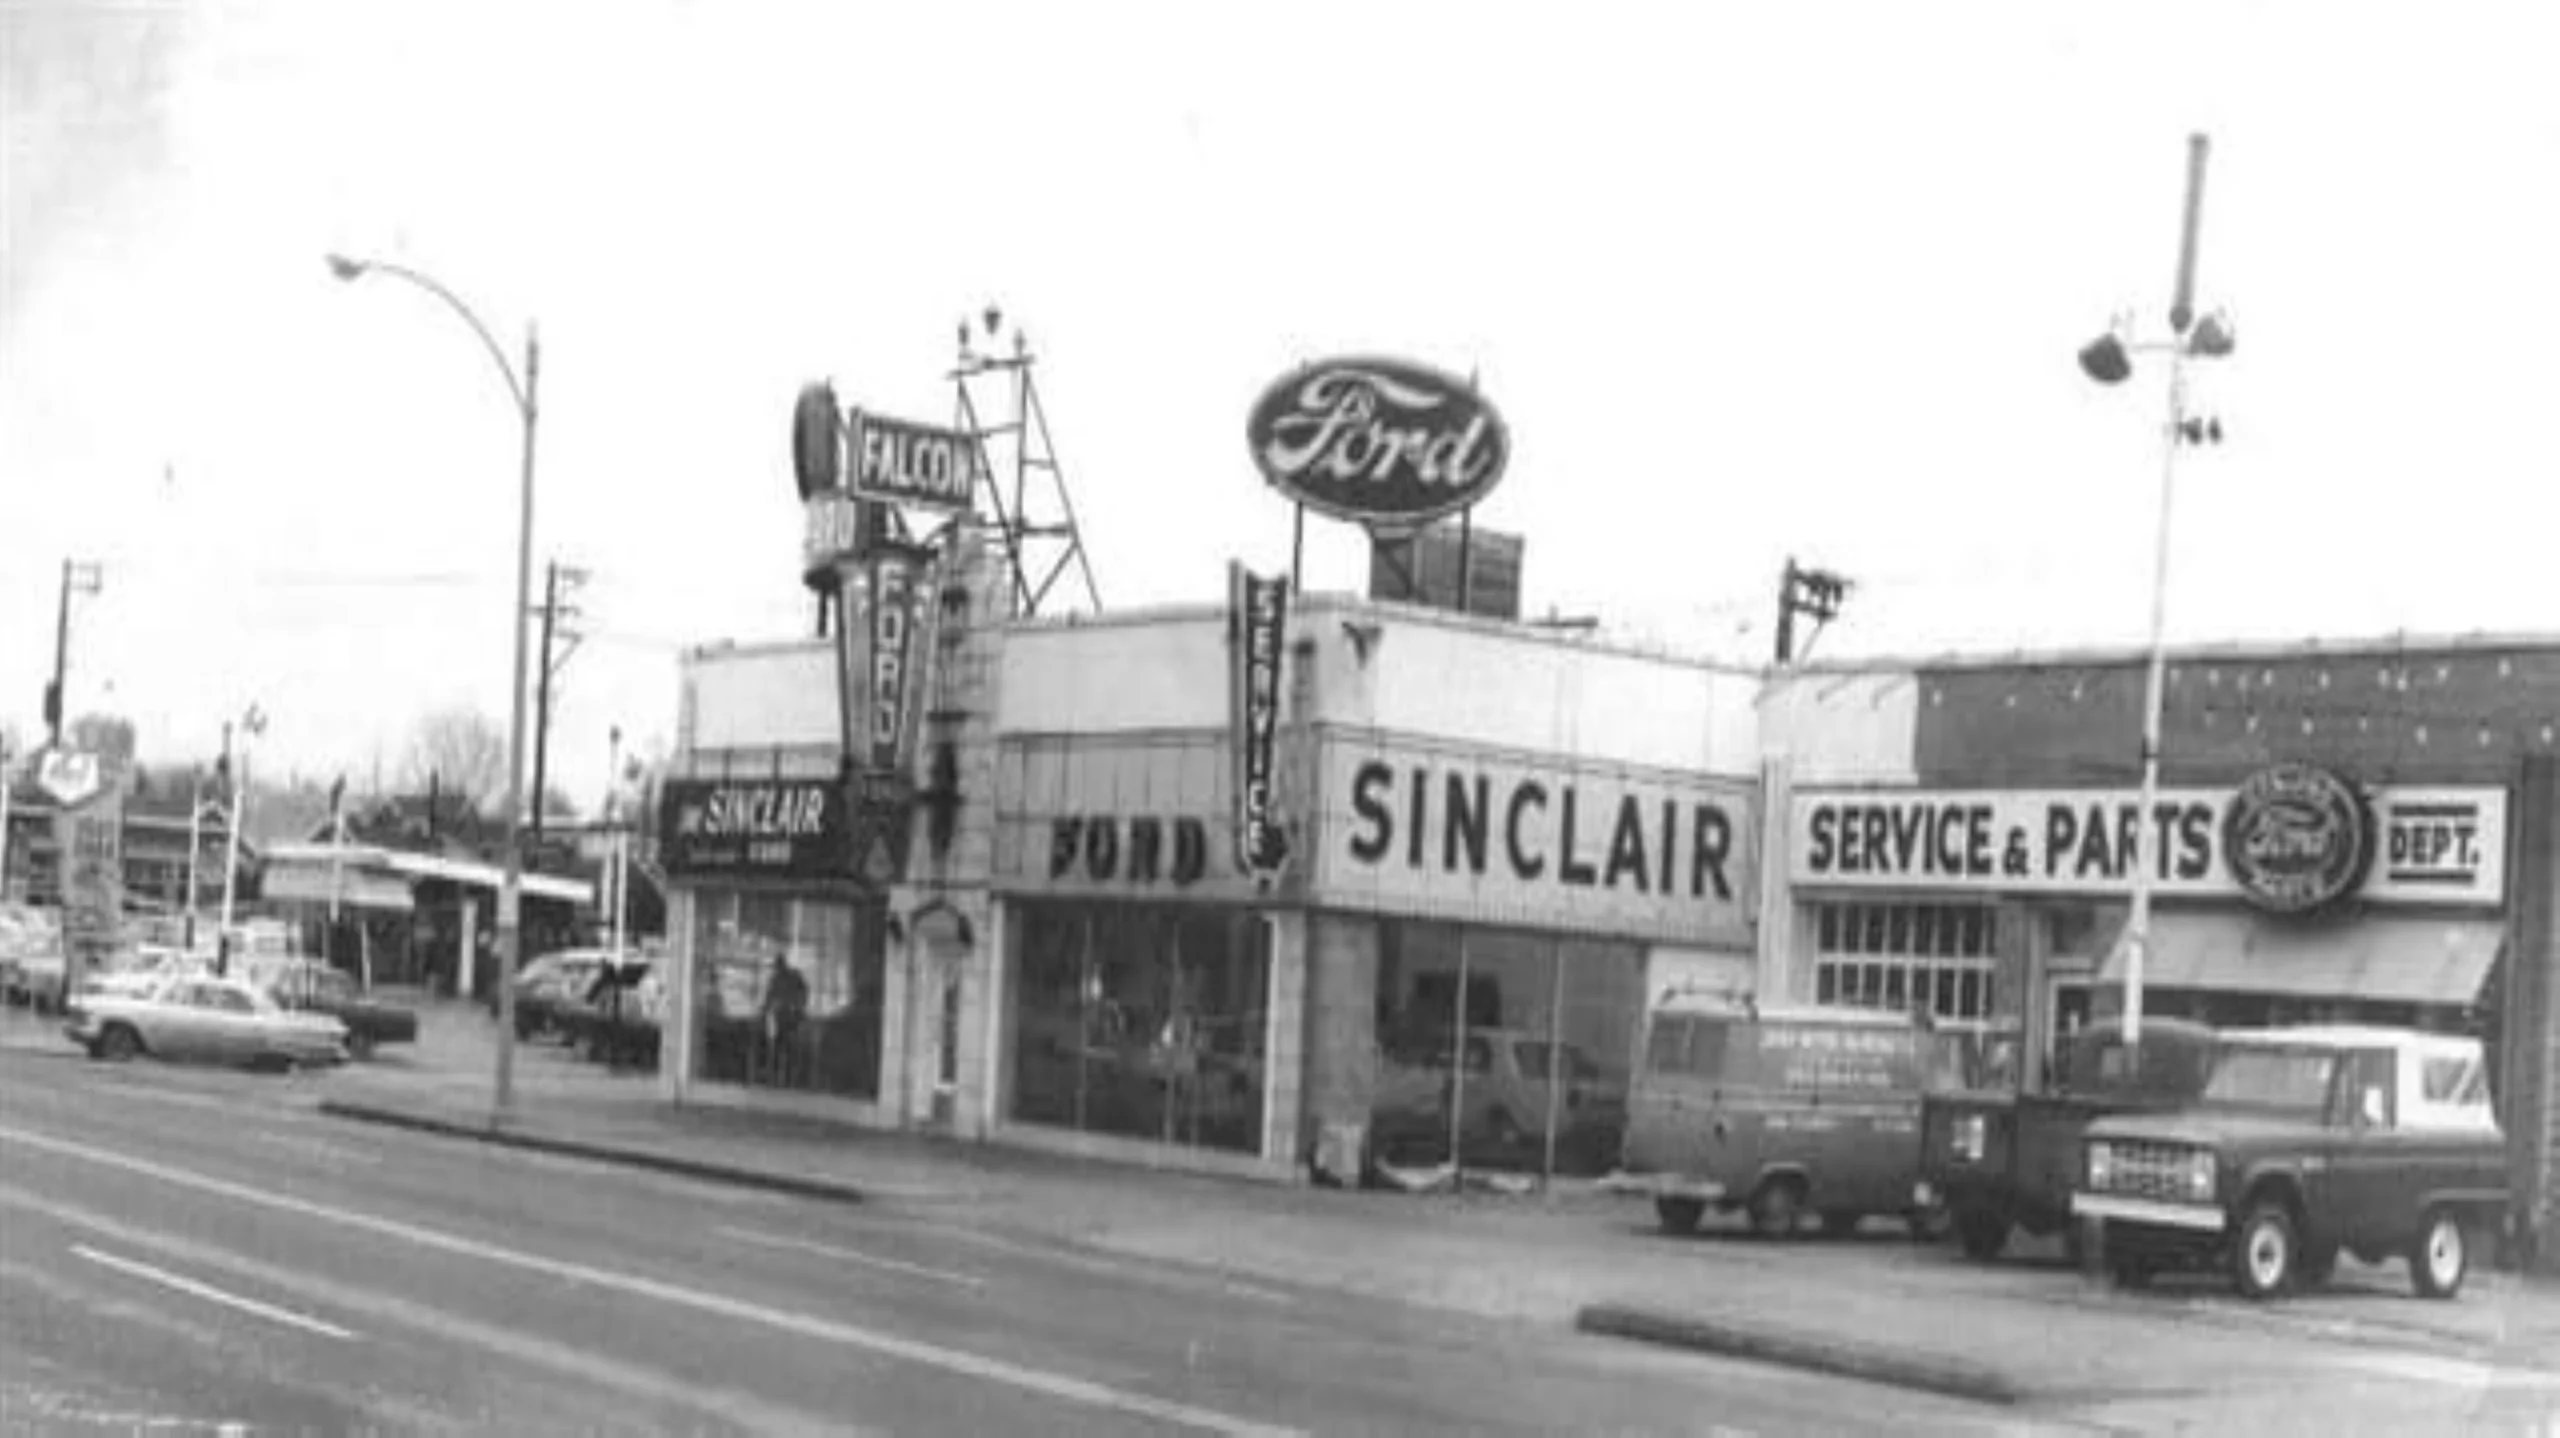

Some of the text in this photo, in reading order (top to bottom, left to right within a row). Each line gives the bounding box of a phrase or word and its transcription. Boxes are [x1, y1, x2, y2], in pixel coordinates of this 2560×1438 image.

[860, 426, 969, 496] FALCON
[1265, 369, 1498, 486] Ford
[876, 560, 904, 744] FORD
[1249, 582, 1278, 858] SERVICE
[705, 786, 825, 838] SINCLAIR
[1347, 760, 1735, 901] SINCLAIR
[1807, 803, 1995, 876] SERVICE
[2004, 826, 2029, 876] &
[2390, 825, 2481, 866] DEPT.
[1050, 814, 1207, 888] FORD
